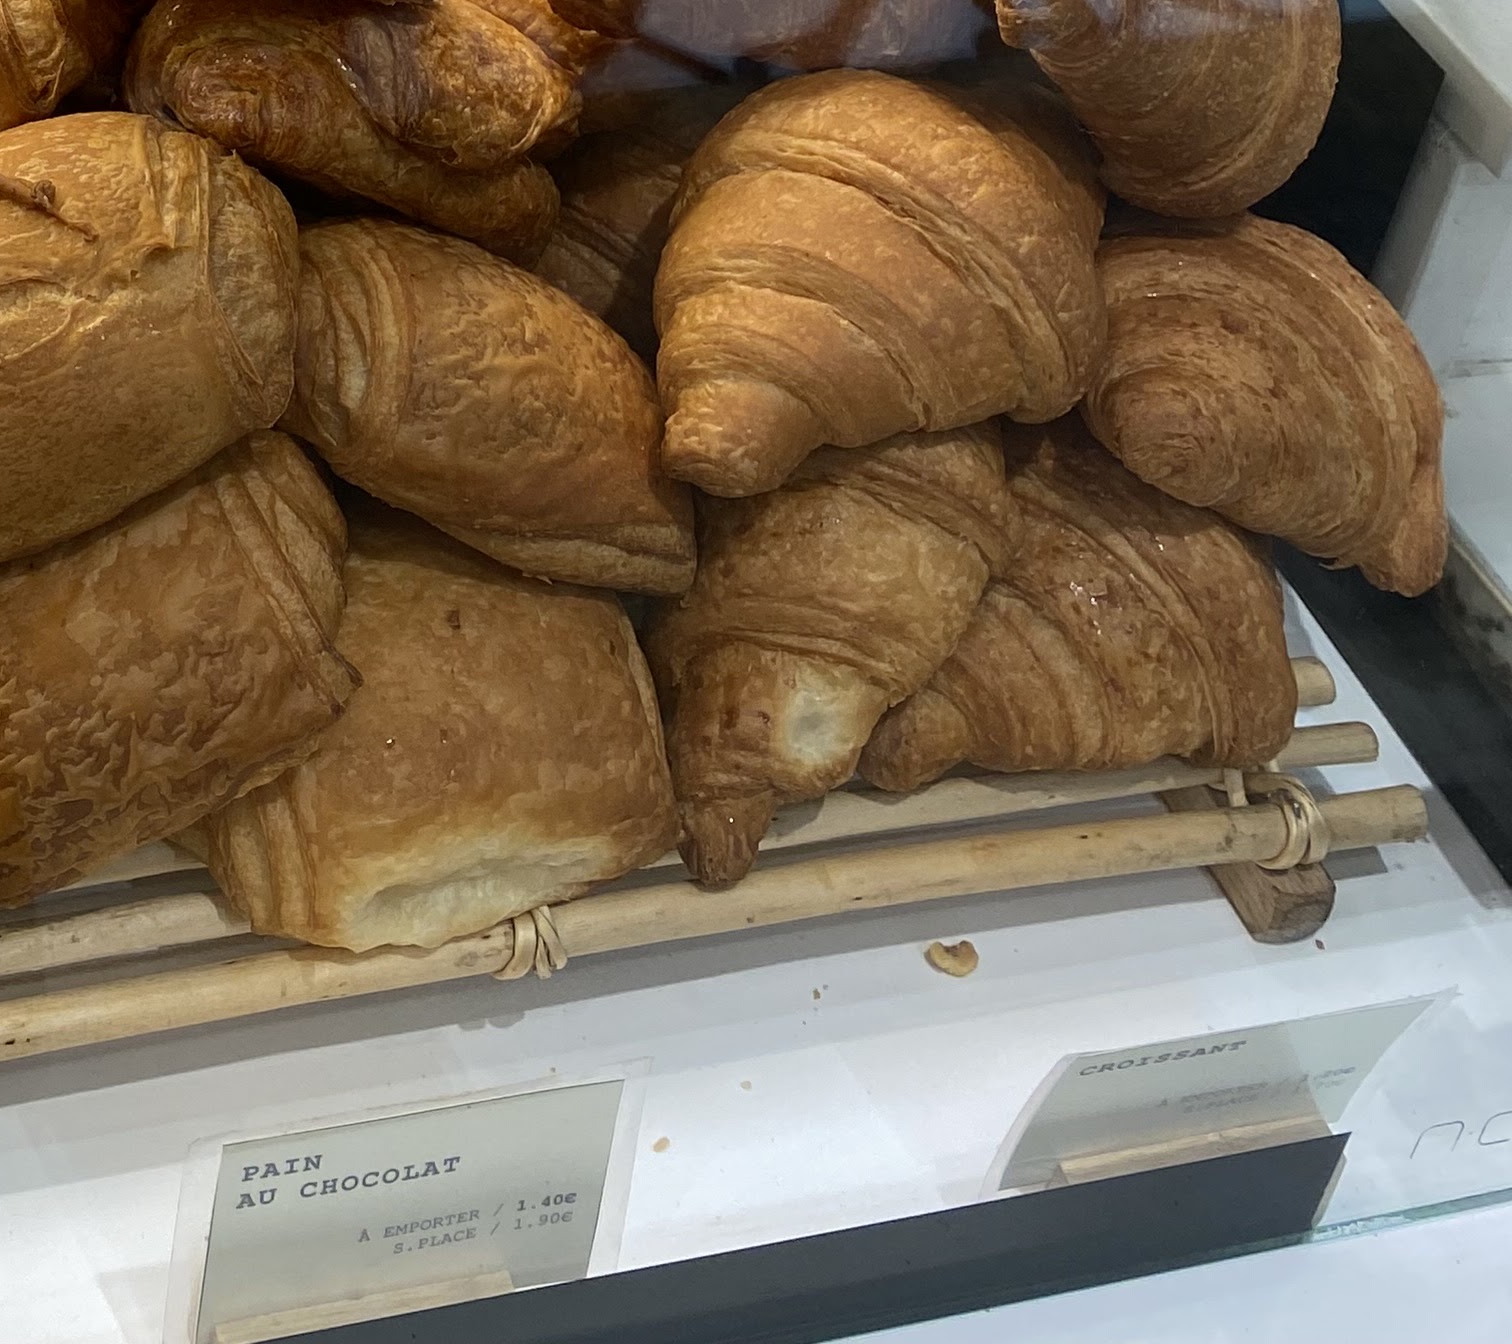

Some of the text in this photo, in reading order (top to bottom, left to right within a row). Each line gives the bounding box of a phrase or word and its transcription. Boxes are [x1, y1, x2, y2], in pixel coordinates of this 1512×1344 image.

[1079, 1040, 1247, 1078] CROISSANT
[235, 1156, 461, 1210] AU CHOCOLAT
[241, 1154, 323, 1182] PAIN
[382, 1209, 480, 1240] EMPORTER
[516, 1192, 577, 1212] 1.40€
[393, 1226, 477, 1255] S.PLACE
[513, 1212, 574, 1231] 1.90€
